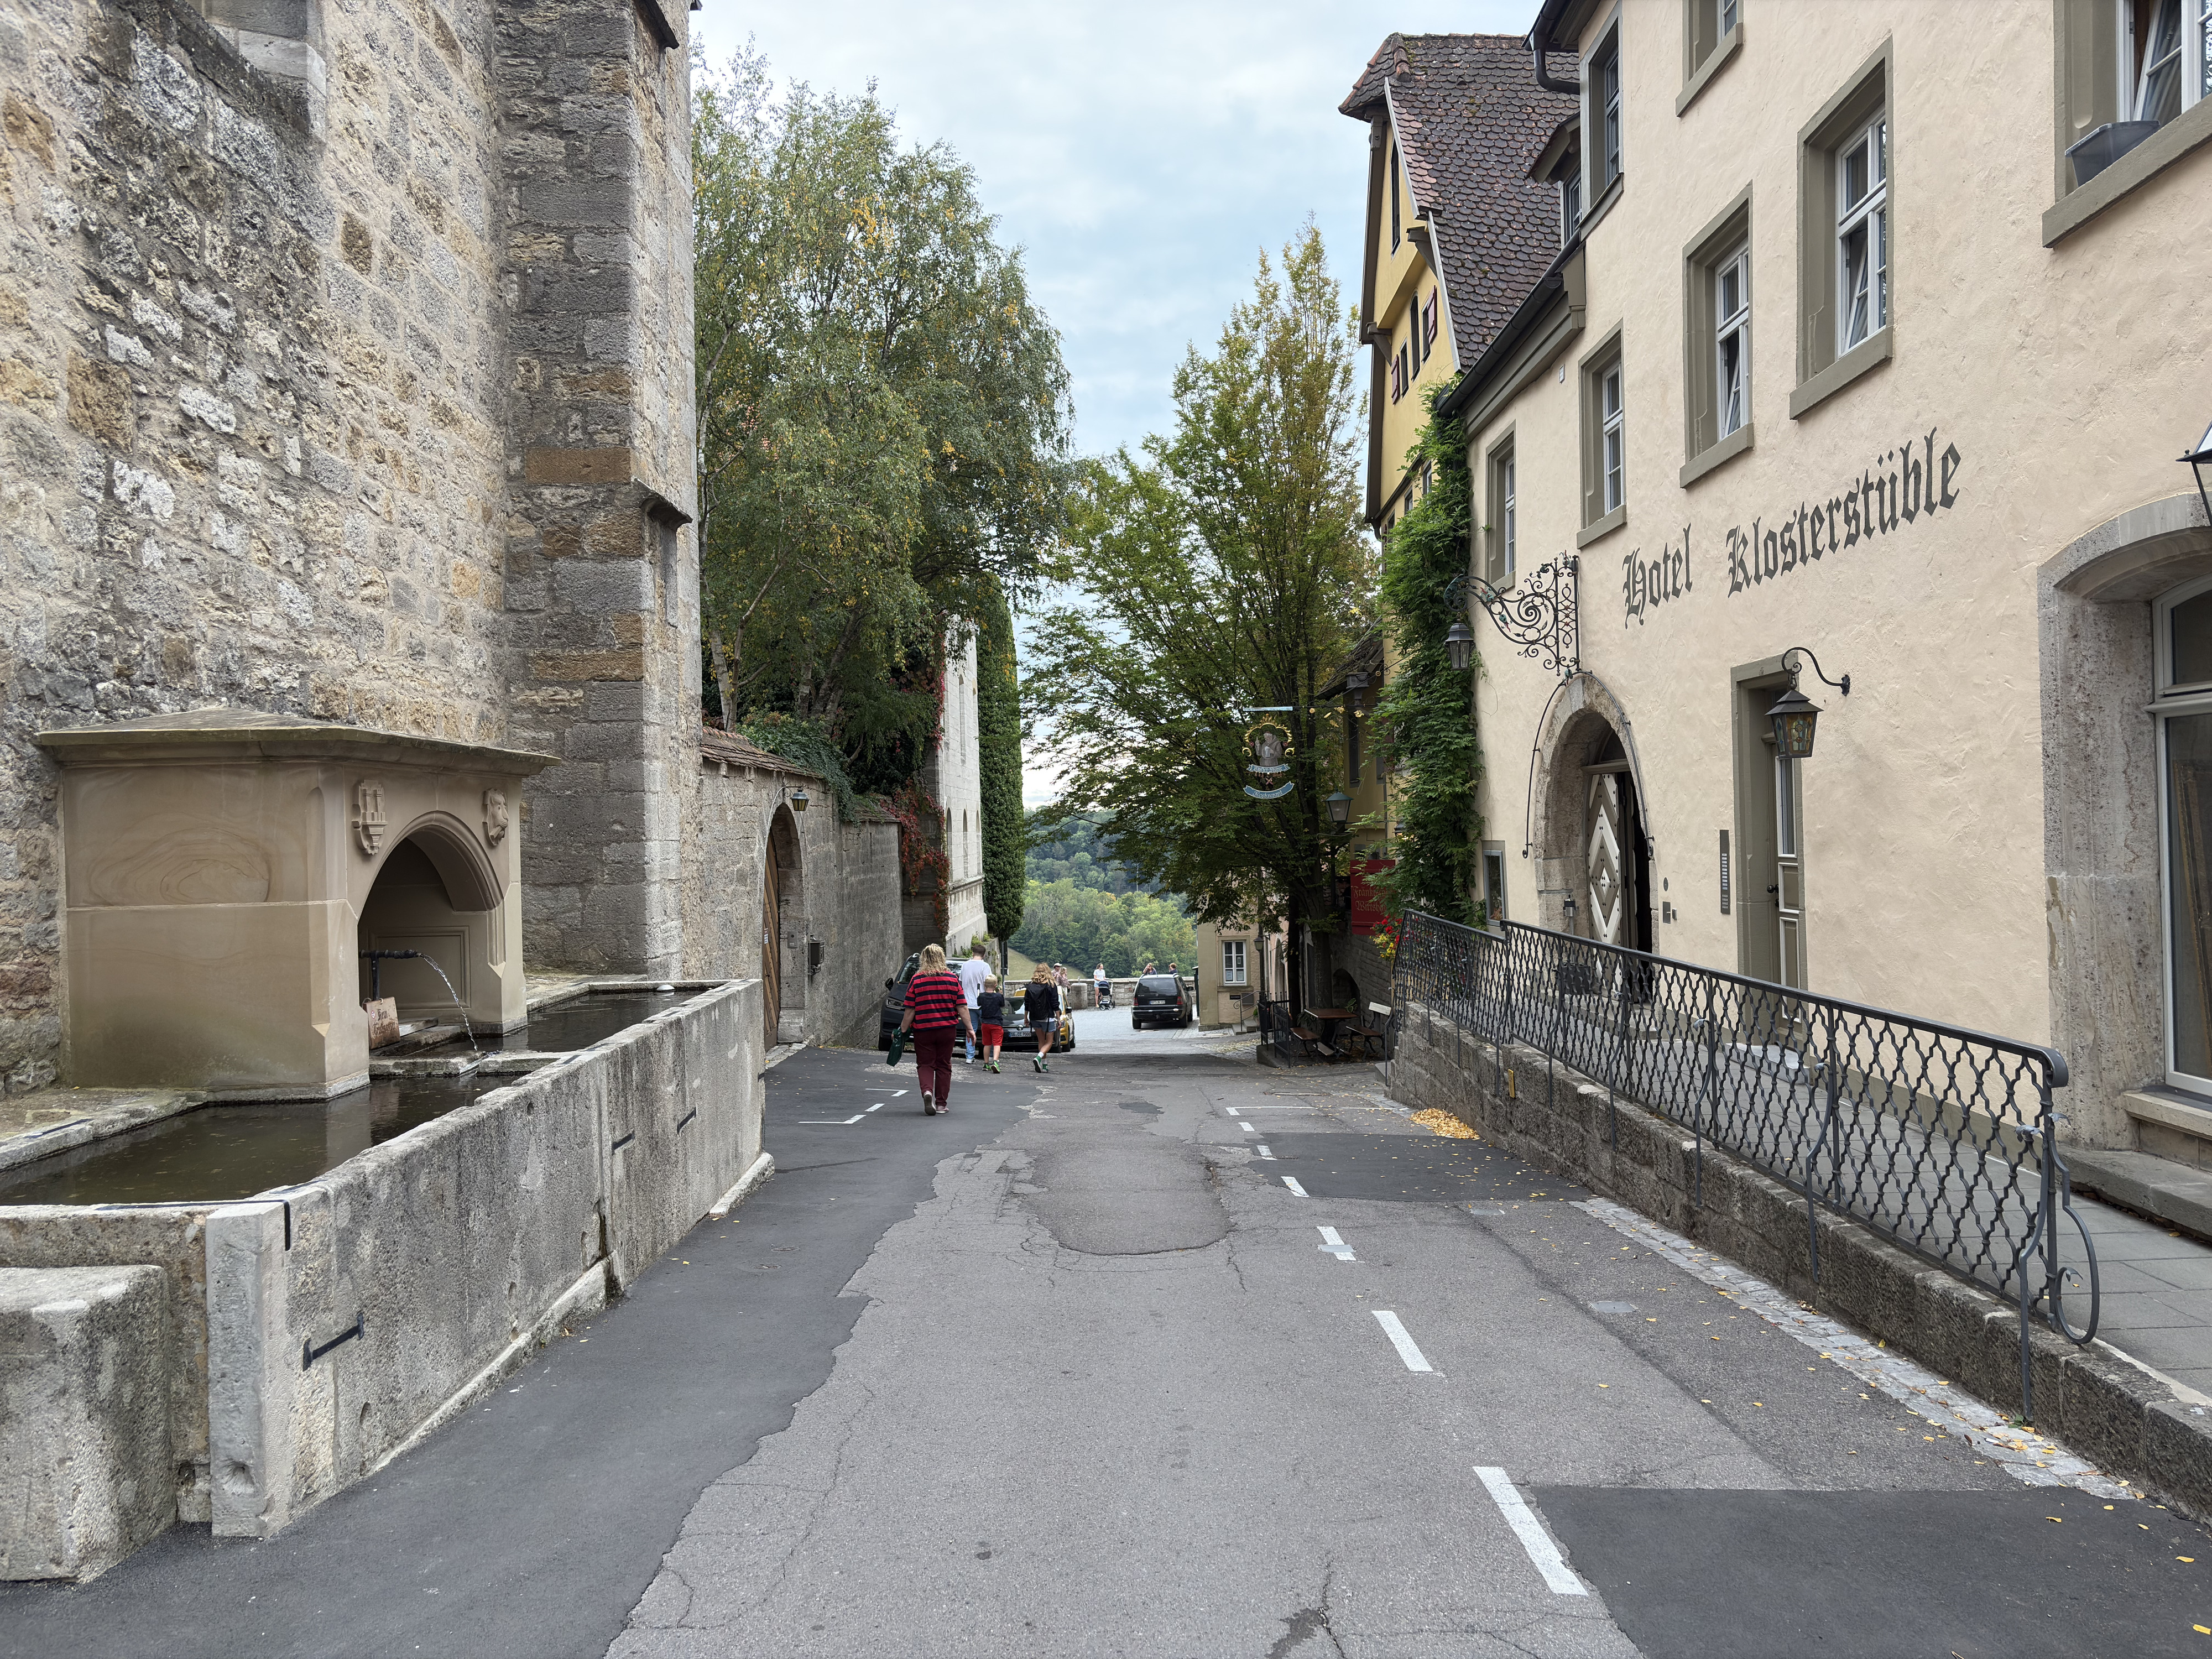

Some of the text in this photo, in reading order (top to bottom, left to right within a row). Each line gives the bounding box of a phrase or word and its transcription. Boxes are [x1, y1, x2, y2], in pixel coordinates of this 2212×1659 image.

[1622, 426, 1961, 629] Hotel Klosterstüble
[1253, 790, 1283, 799] Restaurant
[377, 1009, 388, 1021] Kein
